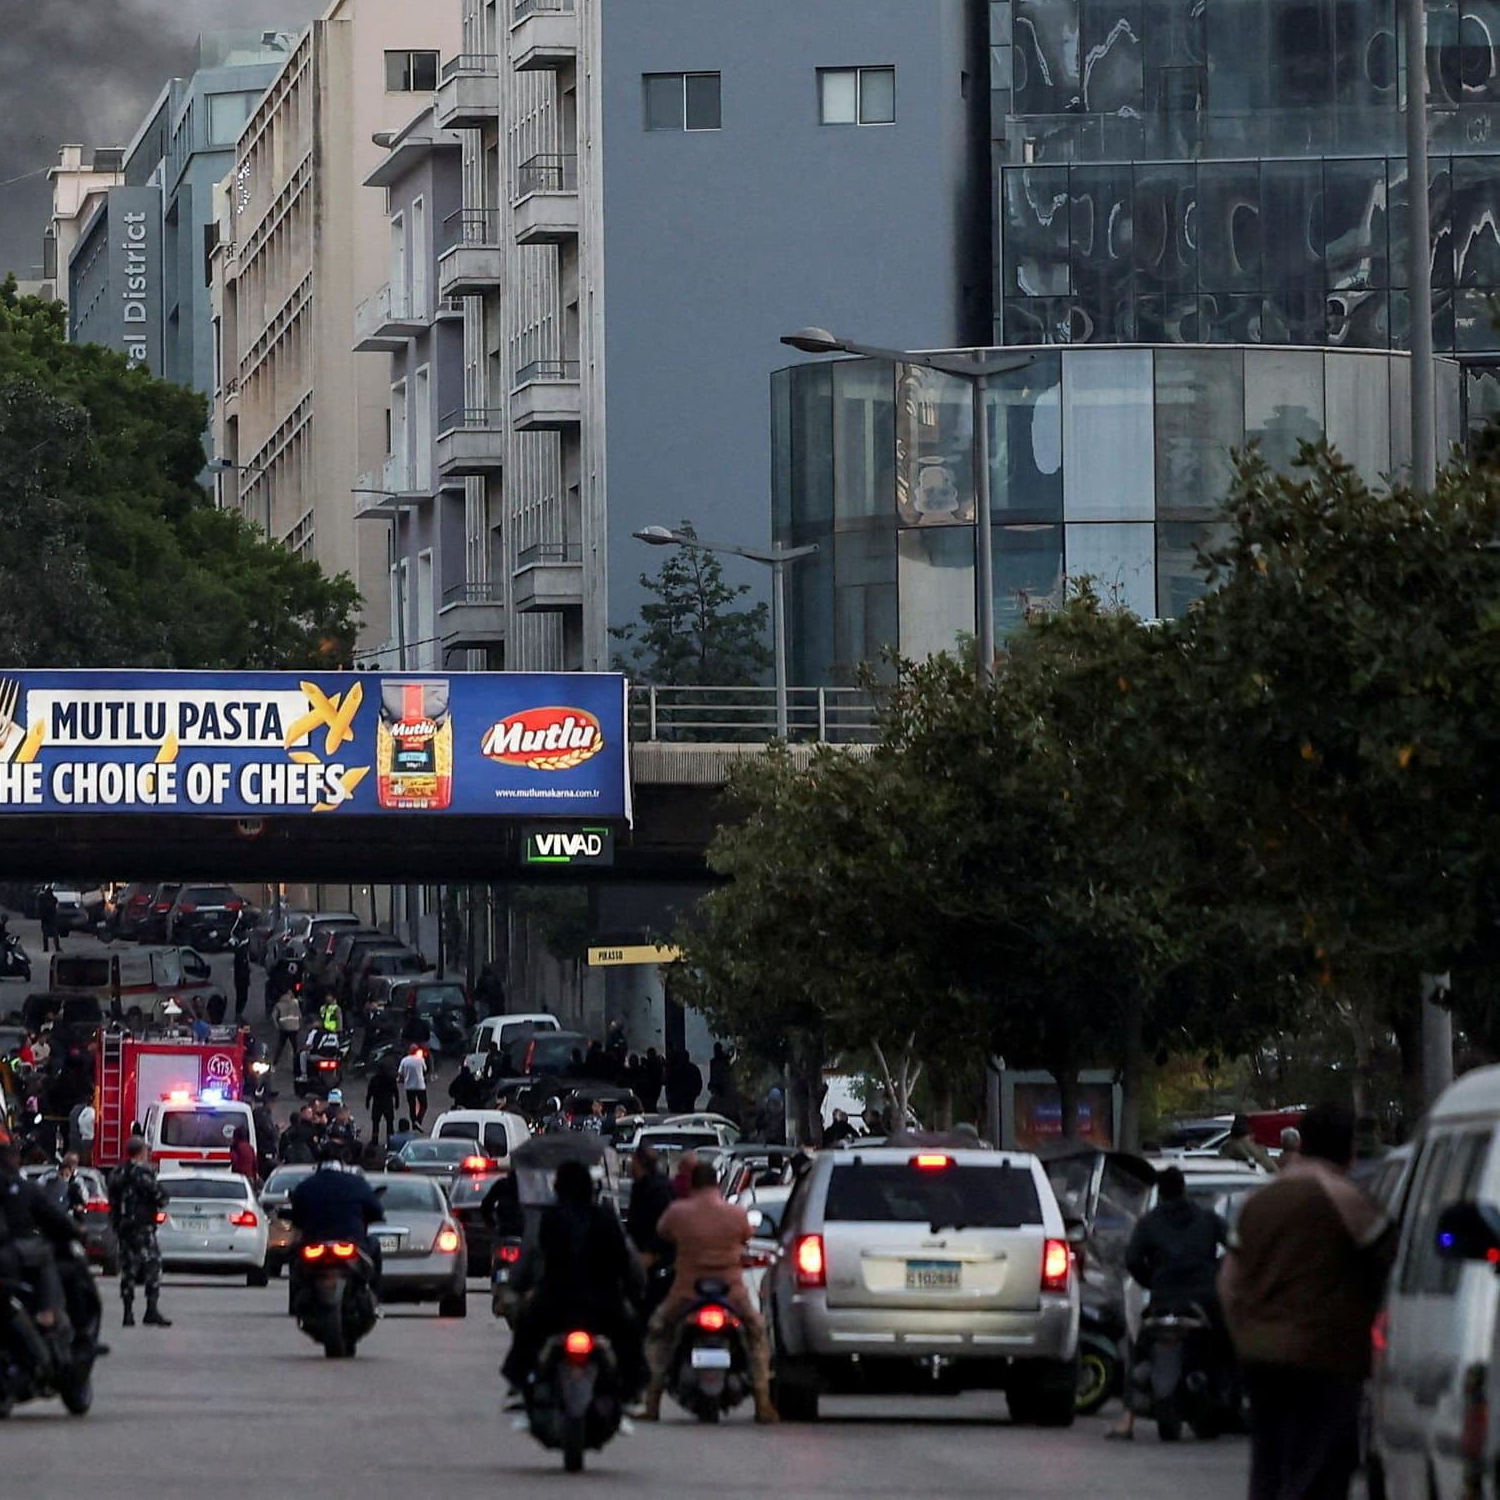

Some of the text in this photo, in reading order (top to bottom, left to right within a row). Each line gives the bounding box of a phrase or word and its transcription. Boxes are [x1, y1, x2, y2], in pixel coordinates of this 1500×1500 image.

[123, 211, 147, 323] District
[51, 701, 284, 740] MUTLU PASTA
[391, 721, 435, 737] Mutlu
[482, 716, 595, 755] Mutlu
[52, 762, 177, 805] CHOICE
[186, 762, 230, 805] OF
[239, 762, 346, 805] CHEFS
[495, 787, 600, 798] www.mutlumakarna.com.tr
[535, 833, 602, 856] VIVAD
